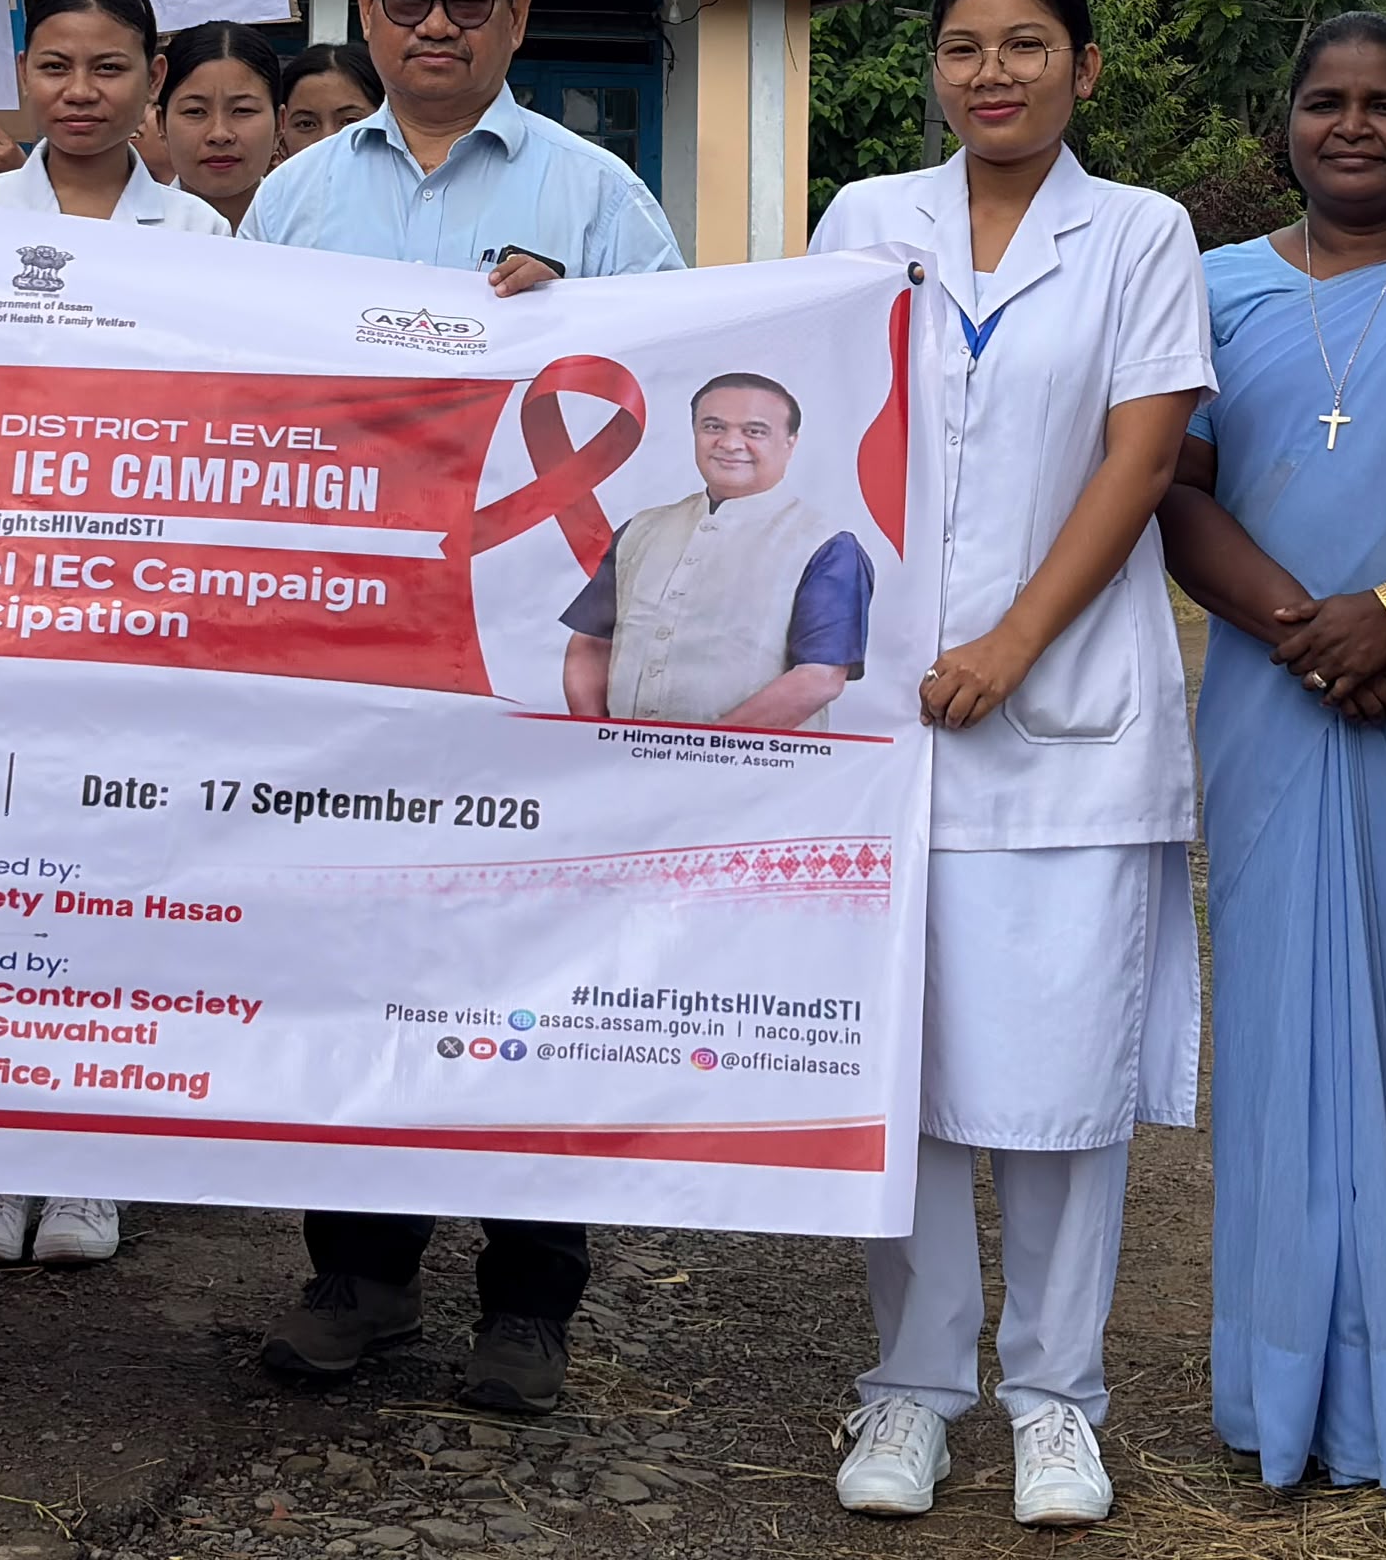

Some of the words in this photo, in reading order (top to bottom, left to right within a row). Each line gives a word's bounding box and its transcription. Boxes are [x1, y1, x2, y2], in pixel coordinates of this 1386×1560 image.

[10, 314, 43, 324] Health
[47, 315, 54, 324] &
[58, 316, 93, 328] Family
[96, 317, 136, 328] Welfare
[44, 300, 55, 310] of
[58, 302, 92, 312] Assam
[356, 336, 423, 350] CONTROL
[427, 346, 487, 355] SOCIETY
[357, 329, 406, 340] ASSAM
[409, 337, 451, 347] STATE
[0, 413, 188, 445] DISTRICT
[205, 421, 337, 452] LEVEL
[12, 449, 89, 498] IEC
[112, 453, 381, 513] CAMPAIGN
[34, 554, 115, 590] IEC
[133, 557, 388, 613] Campaign
[598, 728, 619, 741] Dr
[624, 729, 705, 747] Himanta
[710, 735, 764, 751] Biswa
[769, 739, 832, 756] Sarma
[631, 746, 672, 761] Chief
[676, 750, 738, 765] Minister,
[742, 754, 794, 769] Assam
[82, 774, 169, 810] Date:
[200, 780, 241, 812] 17
[251, 783, 443, 826] September
[453, 794, 541, 831] 2026
[38, 857, 82, 882] by:
[54, 890, 134, 917] Dima
[145, 895, 244, 923] Hasao
[26, 952, 70, 977] by:
[130, 988, 263, 1025] Society
[571, 985, 861, 1021] #IndiaFightsHIVandSTI
[385, 1003, 448, 1024] Please
[455, 1007, 502, 1026] visit:
[538, 1012, 724, 1038] asacs.assam.gov.in
[755, 1023, 861, 1045] naco.gov.in
[536, 1042, 681, 1066] @officialASACS
[720, 1052, 860, 1076] @officialasacs
[73, 1062, 211, 1099] Haflong
